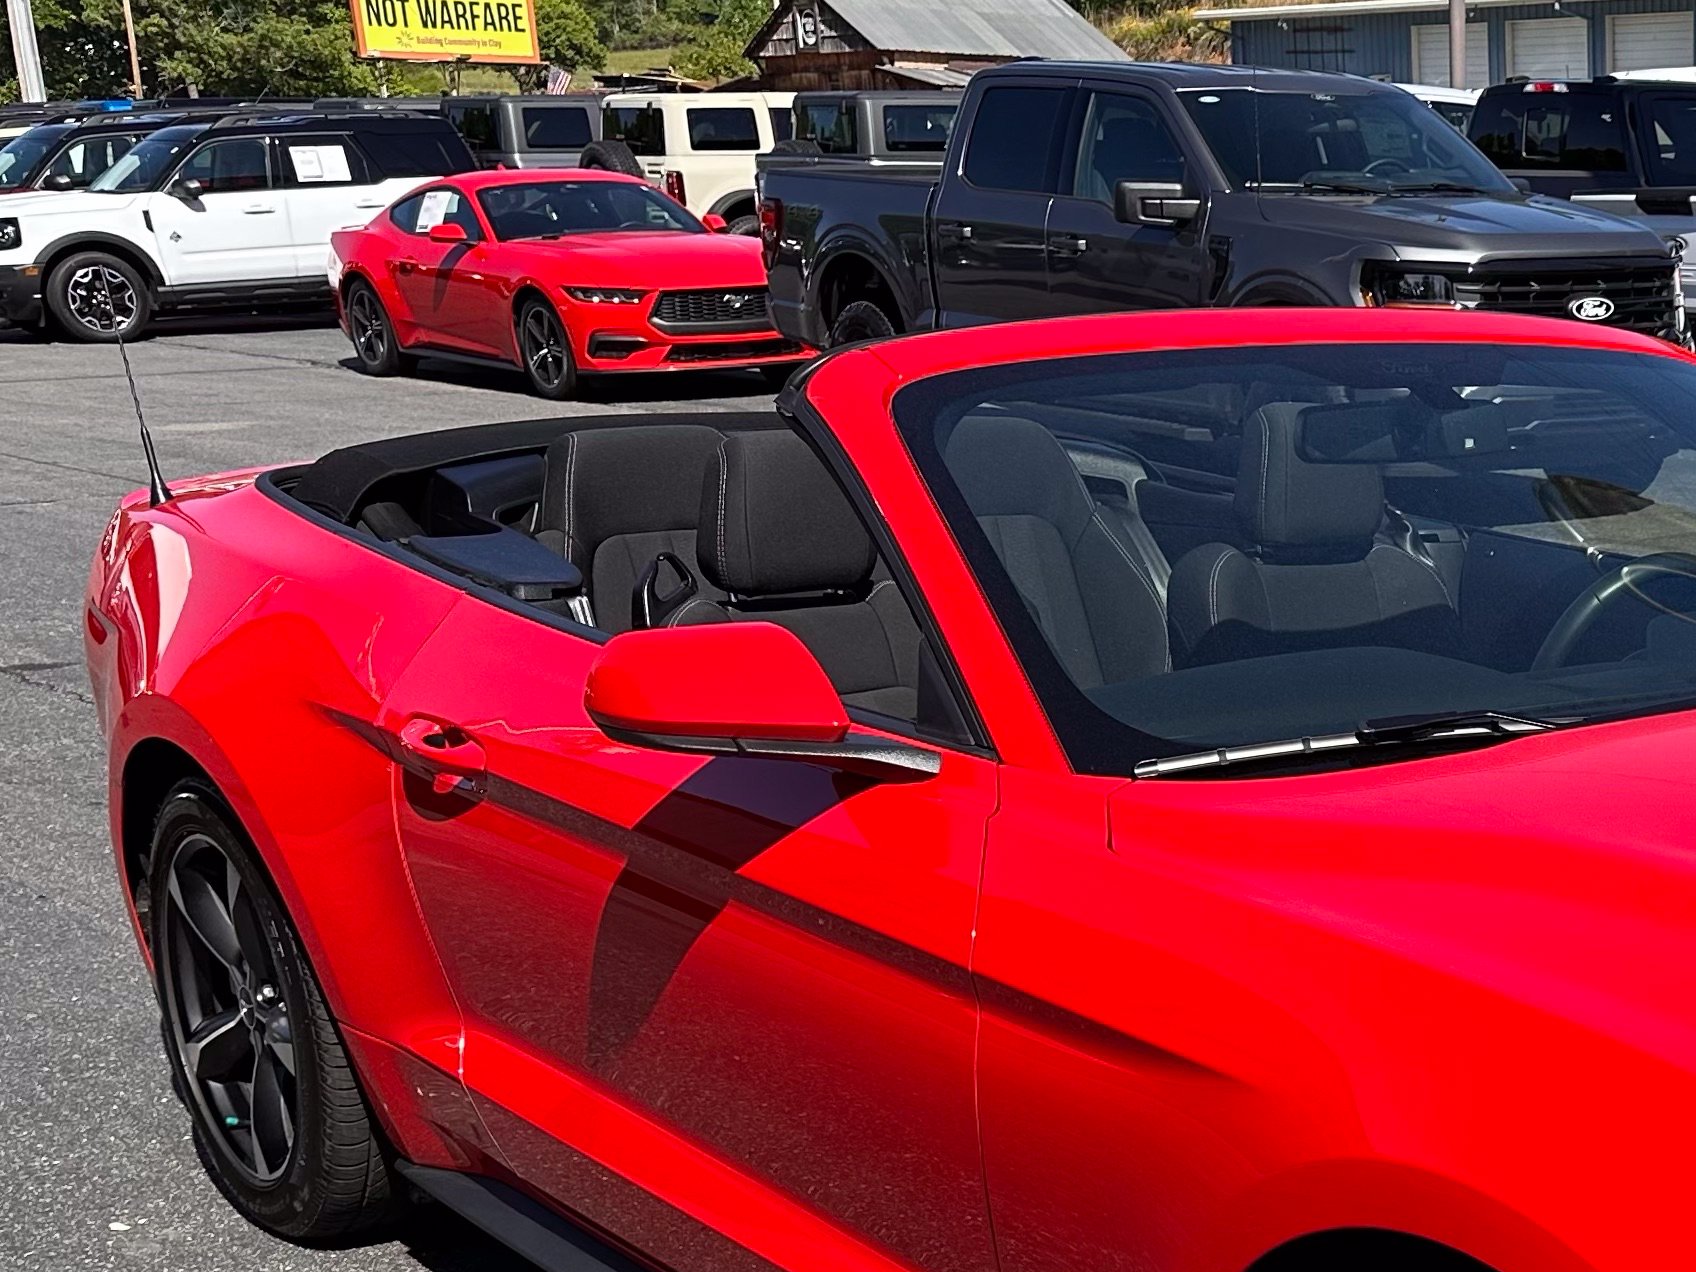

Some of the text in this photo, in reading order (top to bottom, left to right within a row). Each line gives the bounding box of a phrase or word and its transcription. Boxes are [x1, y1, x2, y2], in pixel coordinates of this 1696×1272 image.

[365, 0, 526, 33] NOT WARFARE
[416, 36, 444, 48] Building
[444, 37, 481, 49] Community
[1578, 298, 1610, 318] Ford
